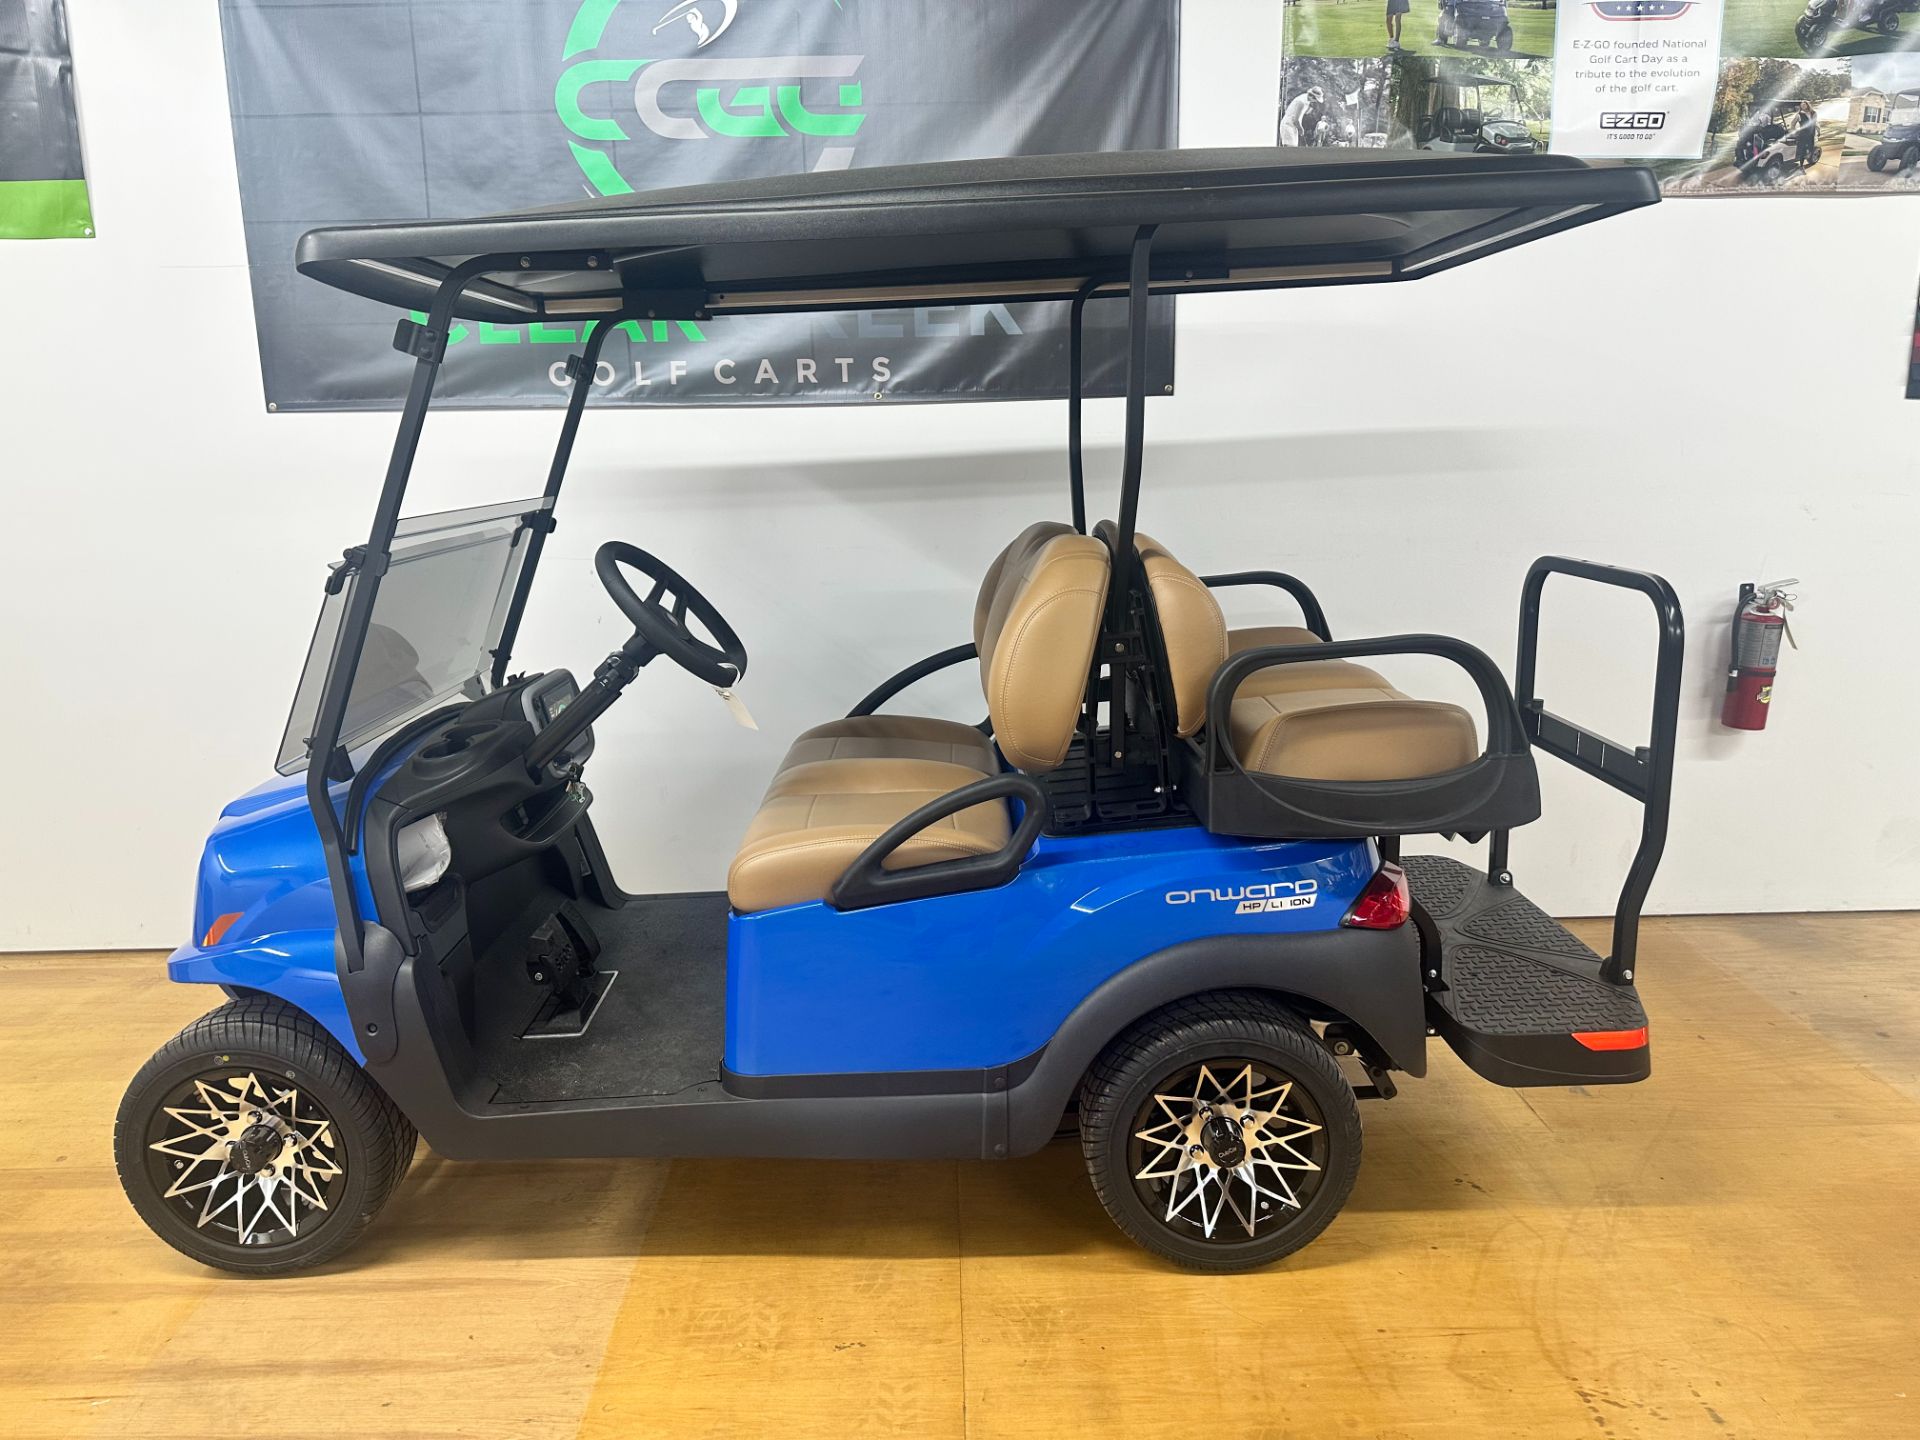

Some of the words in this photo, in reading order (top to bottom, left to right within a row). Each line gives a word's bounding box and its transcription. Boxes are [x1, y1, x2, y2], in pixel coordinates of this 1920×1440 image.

[1573, 40, 1611, 49] E-Z-GO
[1613, 39, 1659, 49] founded
[1662, 39, 1707, 48] National
[1589, 55, 1612, 64] Golf
[1615, 54, 1638, 64] Cart
[1641, 54, 1663, 64] Day
[1666, 55, 1678, 63] as
[1682, 55, 1688, 63] a
[1575, 70, 1612, 79] tribute
[1615, 70, 1626, 78] to
[1629, 69, 1647, 78] the
[1650, 68, 1700, 77] evolution
[1595, 84, 1606, 93] of
[1609, 84, 1627, 93] the
[1630, 84, 1651, 94] golf
[1655, 84, 1679, 92] cart.
[549, 359, 687, 387] GOLF
[714, 356, 892, 385] CARTS
[1289, 897, 1312, 907] ION
